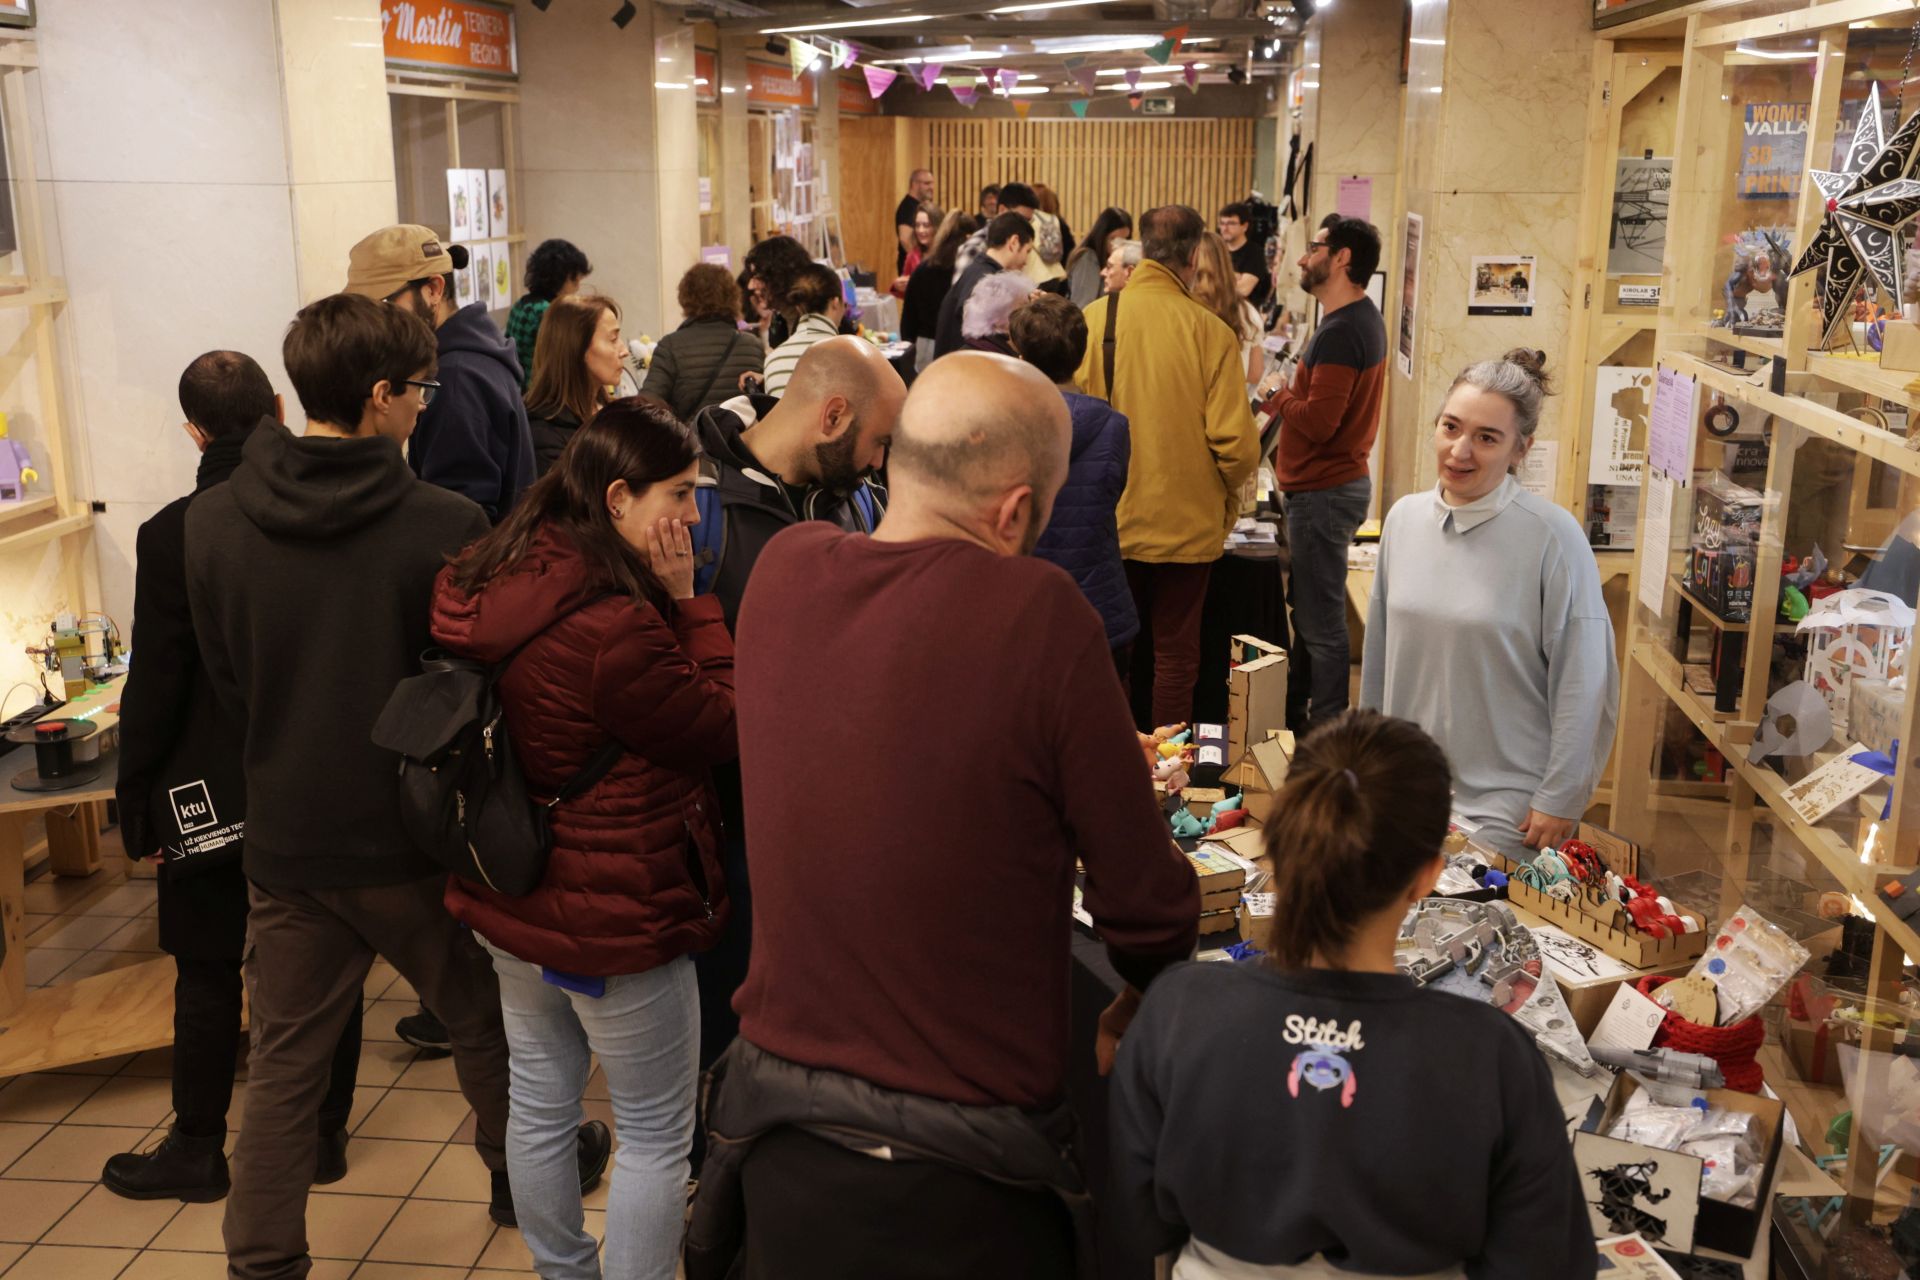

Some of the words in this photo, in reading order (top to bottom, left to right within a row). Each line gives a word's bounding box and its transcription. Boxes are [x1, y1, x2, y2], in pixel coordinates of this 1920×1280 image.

[1748, 146, 1773, 165] 3D
[180, 801, 207, 819] ktu
[194, 827, 231, 843] KIEKVIENOS
[230, 821, 245, 831] TEC
[187, 844, 201, 855] THE
[200, 838, 225, 850] HUMAN
[224, 833, 239, 843] SIDE
[1282, 1014, 1365, 1050] Stitch
